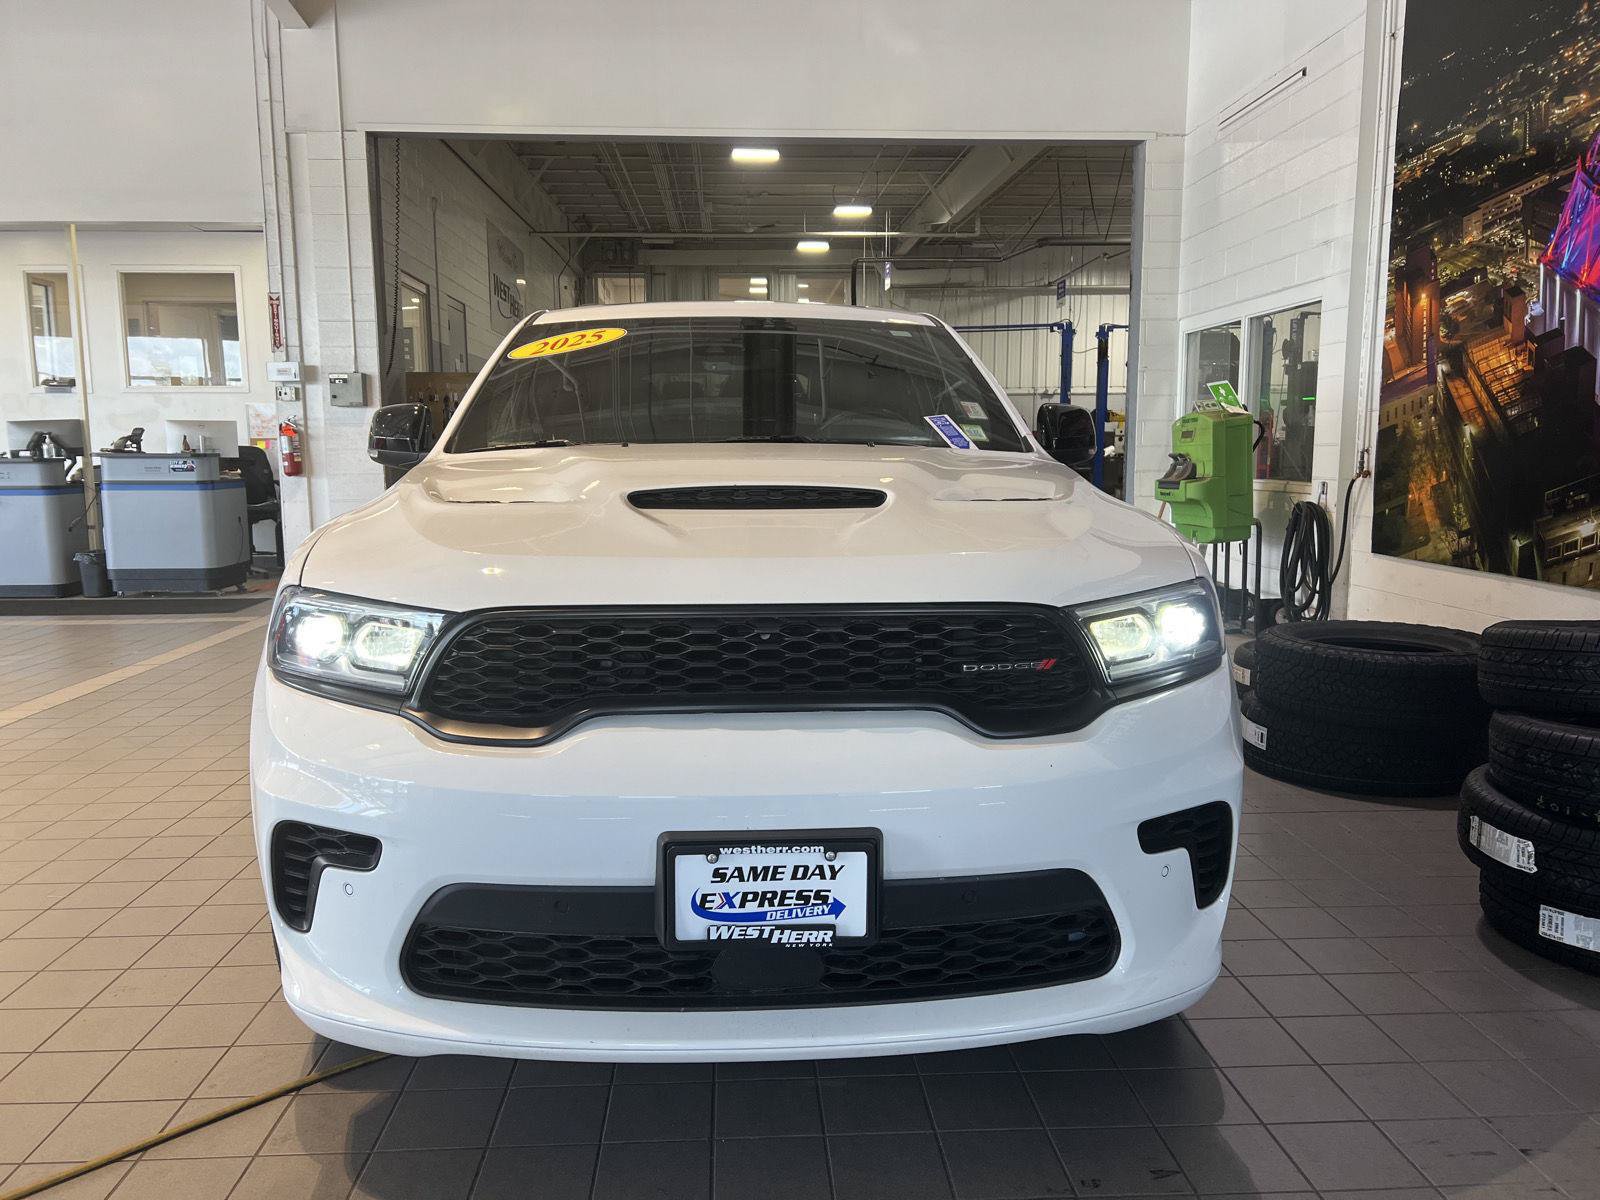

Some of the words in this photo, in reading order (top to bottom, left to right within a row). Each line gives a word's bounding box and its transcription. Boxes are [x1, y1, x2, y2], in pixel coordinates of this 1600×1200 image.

[530, 330, 606, 355] 2025
[963, 662, 1043, 672] DODGE
[719, 845, 824, 855] westherr.com
[710, 865, 787, 884] SAME
[790, 864, 845, 881] DAY
[699, 889, 832, 910] EXPRESS
[766, 904, 832, 921] DELIVERY
